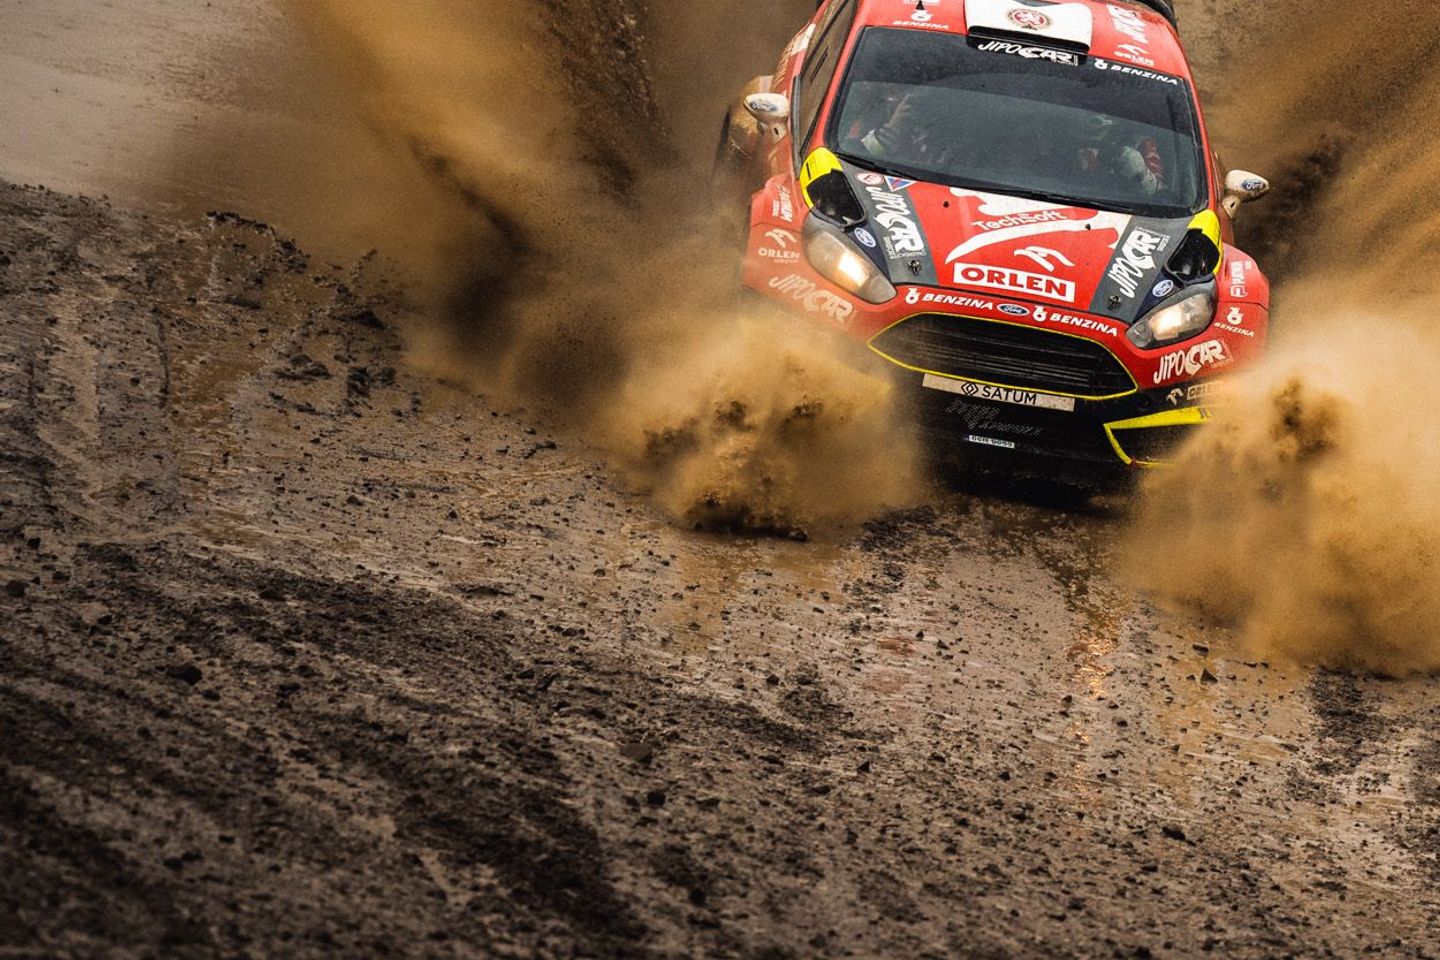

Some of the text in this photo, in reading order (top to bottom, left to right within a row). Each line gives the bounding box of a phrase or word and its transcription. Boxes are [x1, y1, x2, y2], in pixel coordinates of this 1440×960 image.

[978, 40, 1073, 63] JIPOCAR
[1111, 64, 1178, 86] BENZINA
[866, 186, 925, 254] JIPOCAR
[758, 247, 800, 259] ORLEN
[1107, 228, 1161, 298] JIPOCAR
[960, 266, 1067, 297] ORLEN
[768, 274, 853, 324] JIPOCAR
[921, 292, 994, 311] BENZINA
[1050, 312, 1119, 337] BENZINA
[1214, 321, 1255, 338] BENZINA
[1153, 339, 1226, 385] JIPOCAR
[981, 386, 1037, 406] SATUM
